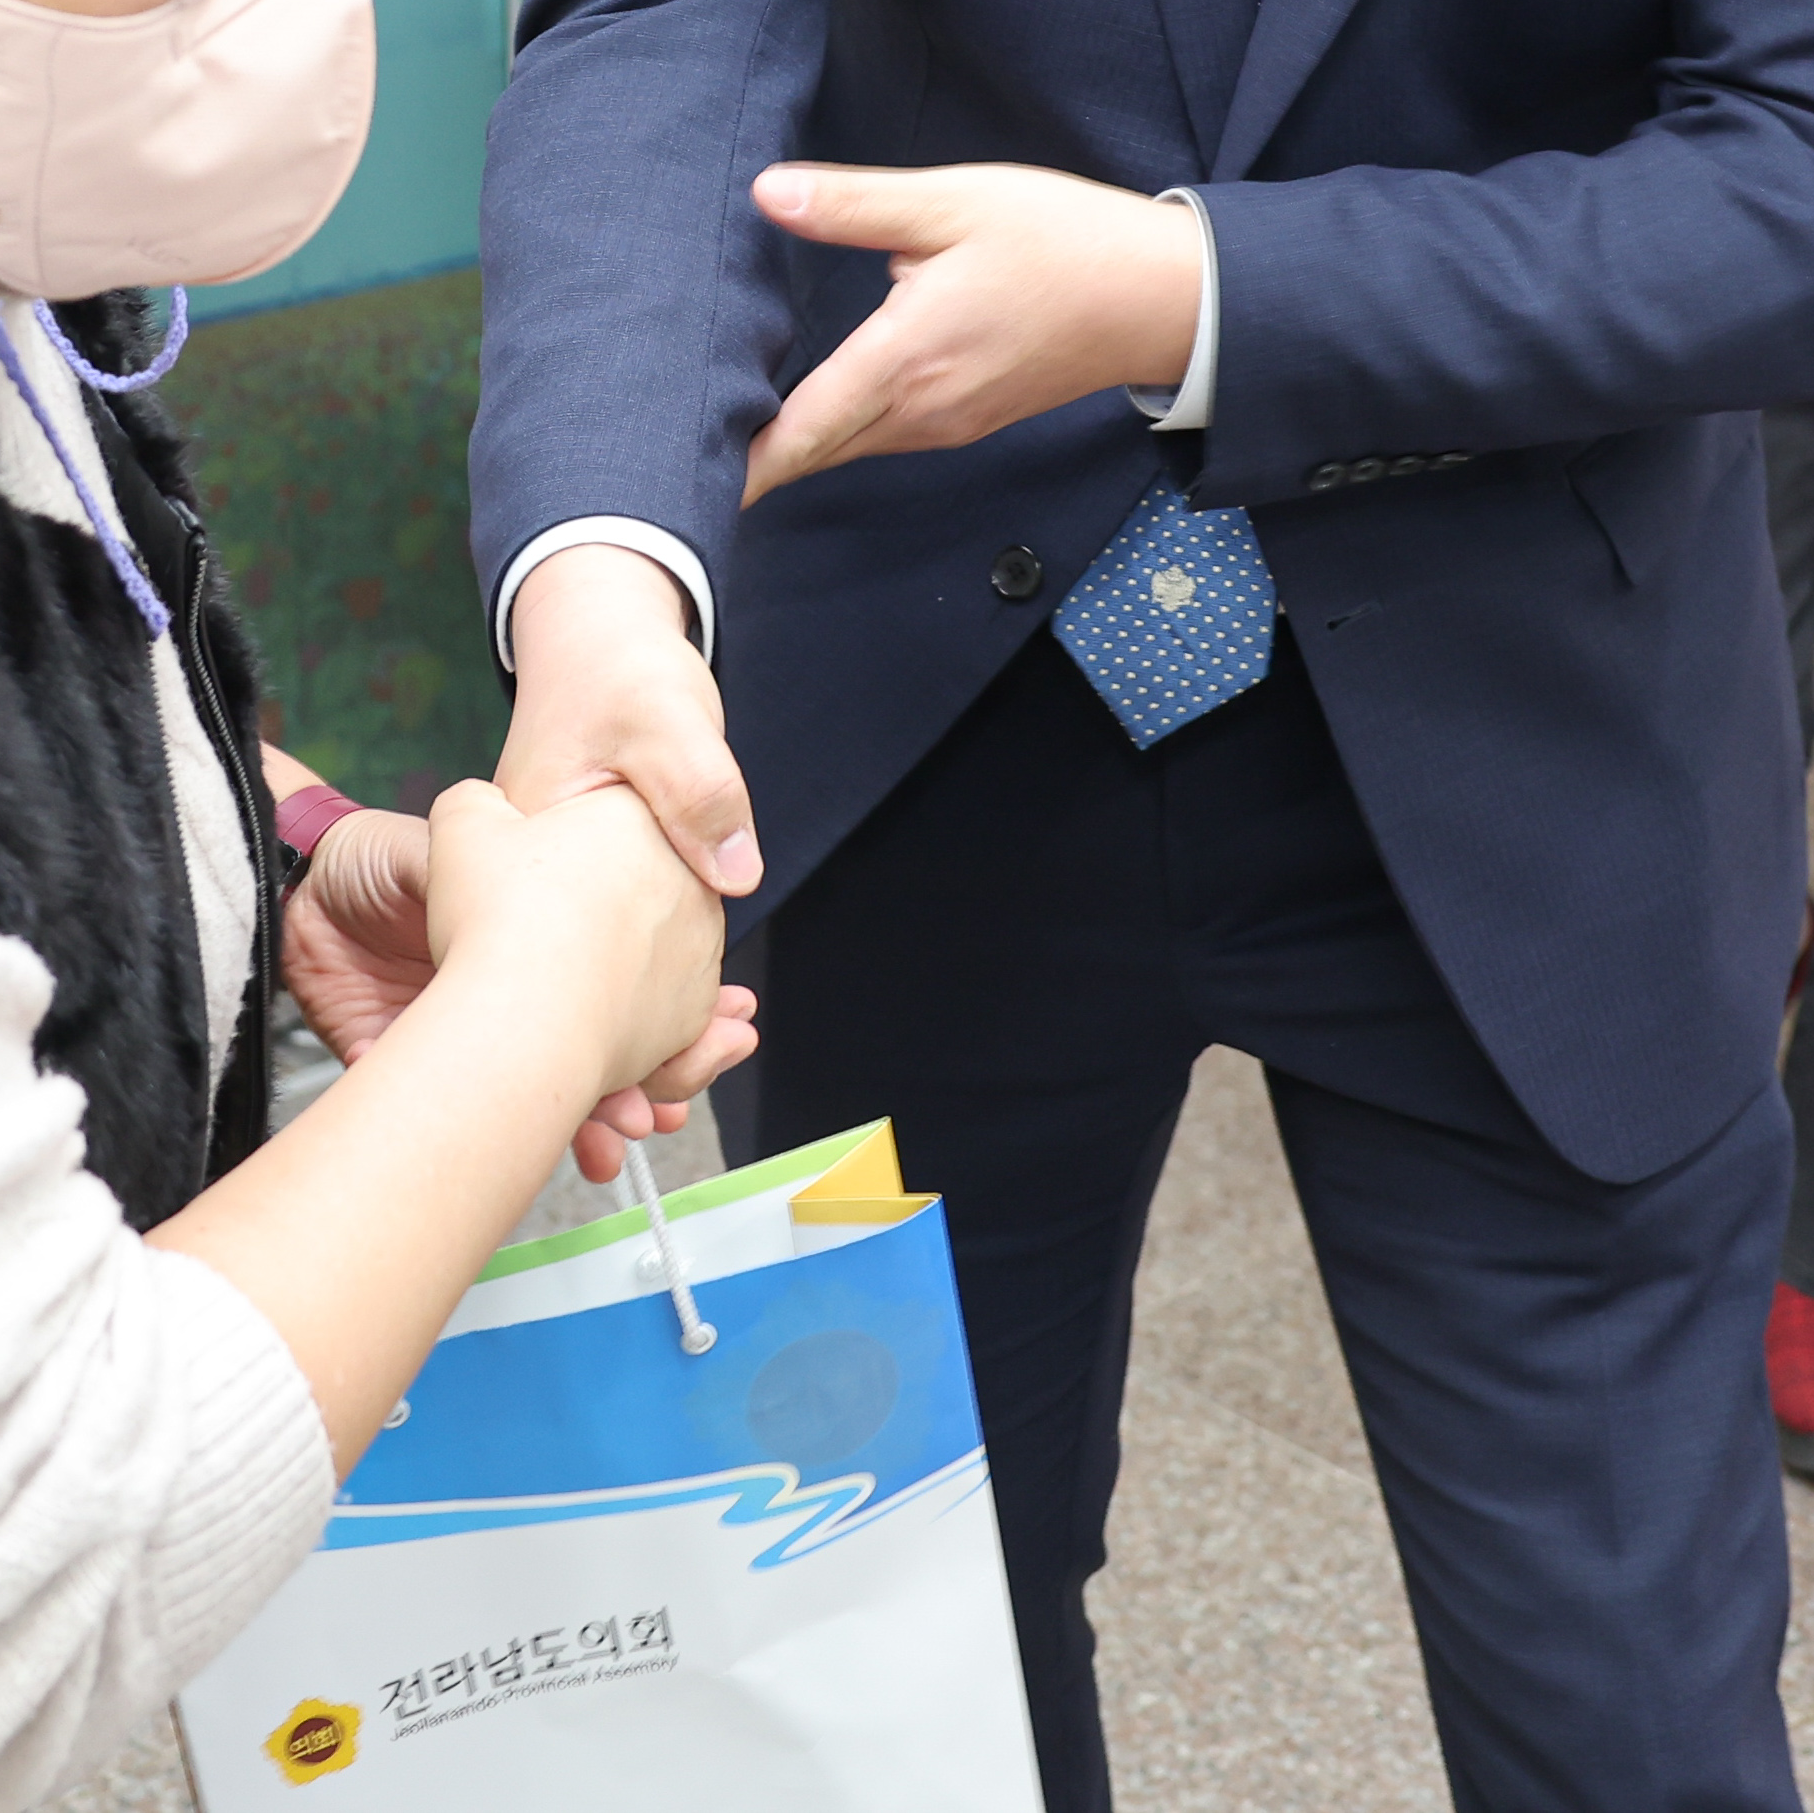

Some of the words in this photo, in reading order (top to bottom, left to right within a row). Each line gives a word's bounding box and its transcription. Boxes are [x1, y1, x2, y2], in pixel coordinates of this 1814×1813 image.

[379, 1604, 676, 1722] 전라남도의회
[390, 1696, 499, 1742] Jeollanamdo
[503, 1673, 587, 1705] Provincial
[591, 1652, 680, 1685] Assembly
